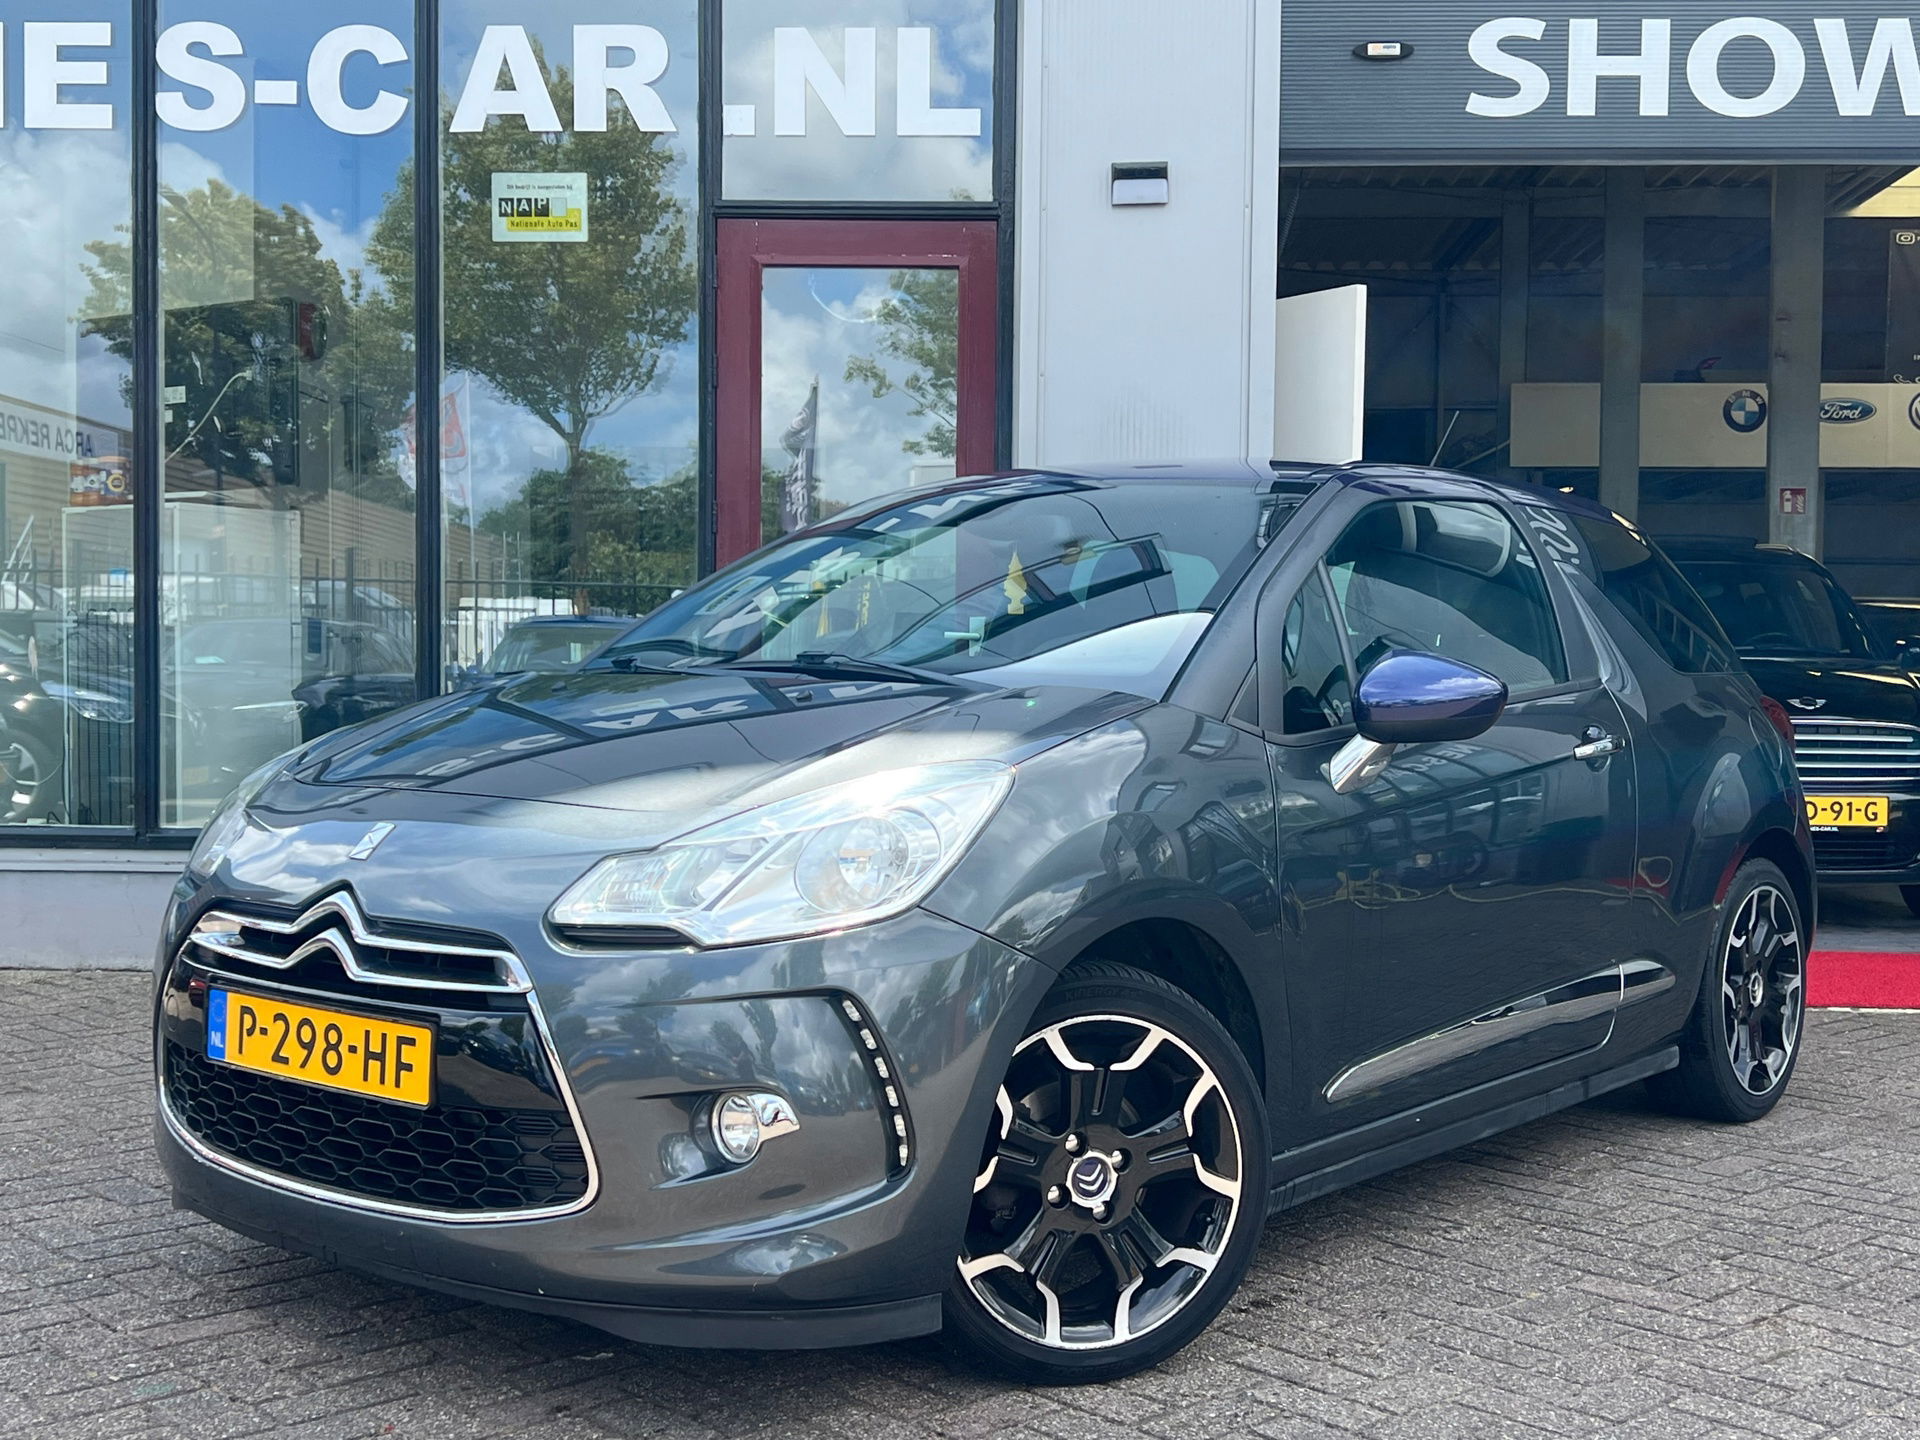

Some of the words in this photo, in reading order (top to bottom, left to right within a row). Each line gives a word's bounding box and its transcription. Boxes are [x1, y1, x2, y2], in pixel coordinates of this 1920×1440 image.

[1465, 16, 1920, 118] SHOW
[0, 21, 981, 137] ES-CAR.NL
[501, 198, 547, 214] NAP
[510, 219, 545, 229] Nationale
[547, 219, 563, 228] Auto
[565, 219, 578, 228] Pas
[1820, 402, 1862, 420] Ford
[211, 1030, 224, 1049] NL
[238, 1004, 417, 1089] P-298-HF
